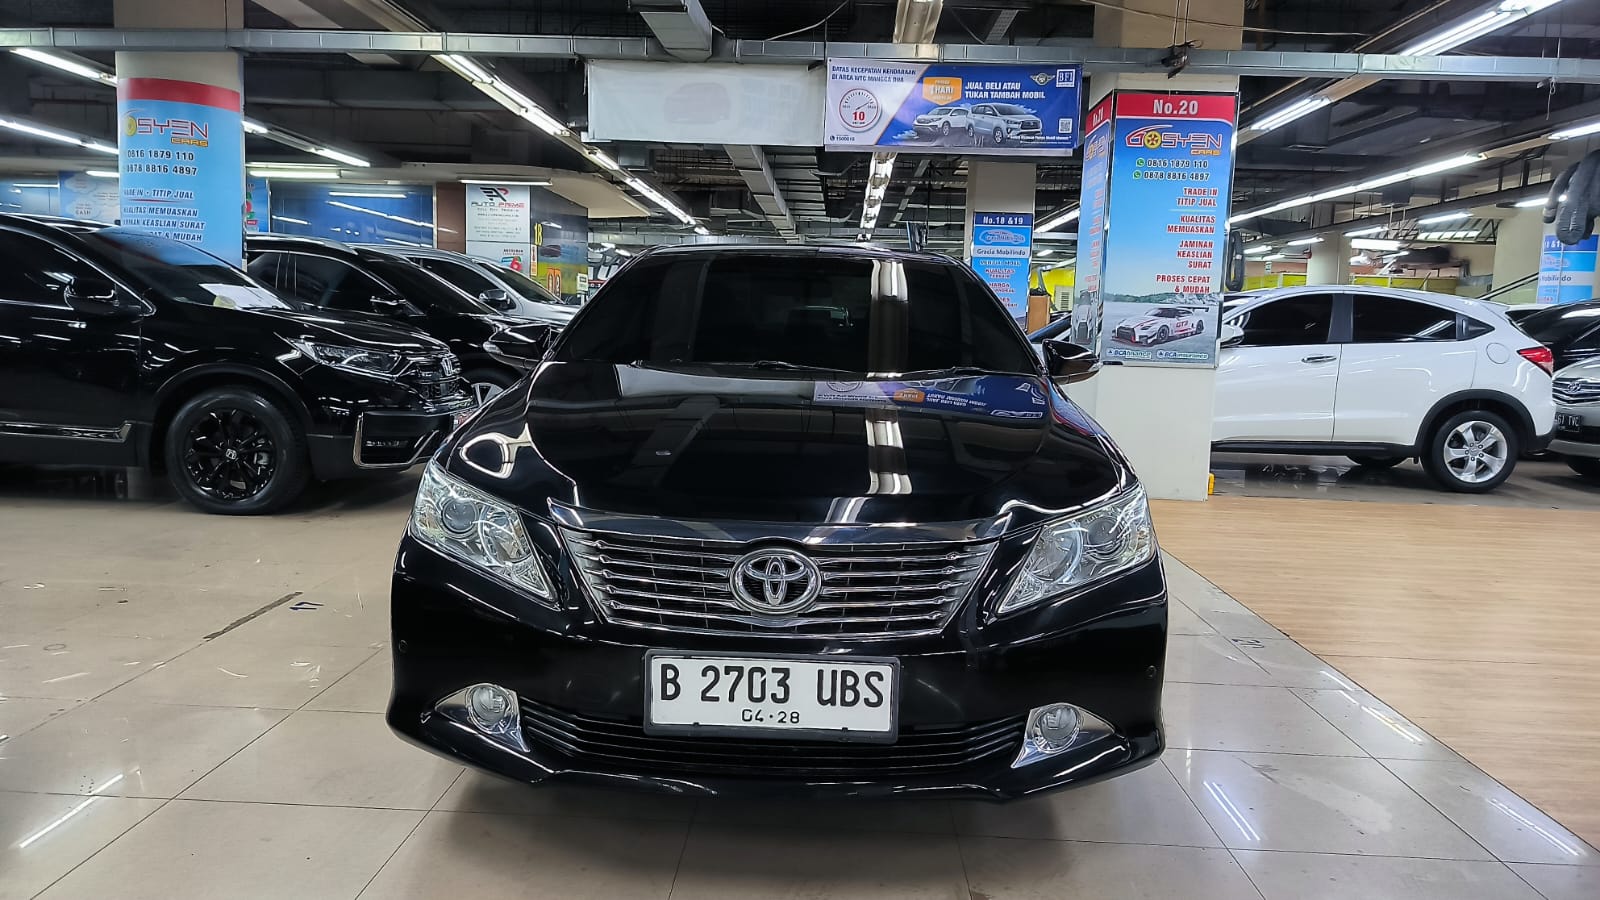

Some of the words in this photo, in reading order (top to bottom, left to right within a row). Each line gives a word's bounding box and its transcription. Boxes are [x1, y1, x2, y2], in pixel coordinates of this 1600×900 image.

[965, 82, 984, 90] JUAL
[986, 82, 1002, 90] BELI
[1002, 82, 1021, 90] ATAU
[965, 90, 988, 98] TUKAR
[990, 91, 1020, 99] TAMBAH
[1153, 99, 1199, 115] No.20
[852, 111, 866, 121] 10
[171, 137, 208, 148] CARS
[148, 150, 172, 160] 1879
[176, 152, 195, 161] 110
[1147, 159, 1168, 168] 0816
[1194, 160, 1208, 168] 110
[146, 164, 169, 174] 8816
[172, 166, 198, 176] 4897
[1144, 170, 1164, 180] 0878
[1190, 172, 1210, 180] 4897
[152, 189, 172, 198] TITIP
[174, 190, 194, 199] JUAL
[1183, 187, 1207, 196] TRADE
[1209, 188, 1218, 196] IN
[1176, 197, 1196, 206] TITIP
[1198, 198, 1217, 207] JUAL
[148, 207, 198, 217] MEMUASKAN
[142, 218, 177, 228] KEASLIAN
[178, 221, 206, 230] SURAT
[983, 216, 1005, 224] No.18
[1180, 215, 1216, 224] KUALITAS
[1167, 224, 1215, 234] MEMUASKAN
[534, 223, 543, 246] 18
[1179, 240, 1214, 249] JAMINAN
[1176, 250, 1213, 258] KEASLIAN
[1188, 260, 1212, 268] SURAT
[1156, 274, 1186, 283] PROSES
[1188, 276, 1211, 284] CEPAT
[1174, 286, 1182, 294] &
[1183, 285, 1210, 294] MUDAH
[660, 664, 681, 700] B
[700, 665, 791, 704] 2703
[816, 668, 884, 708] UBS
